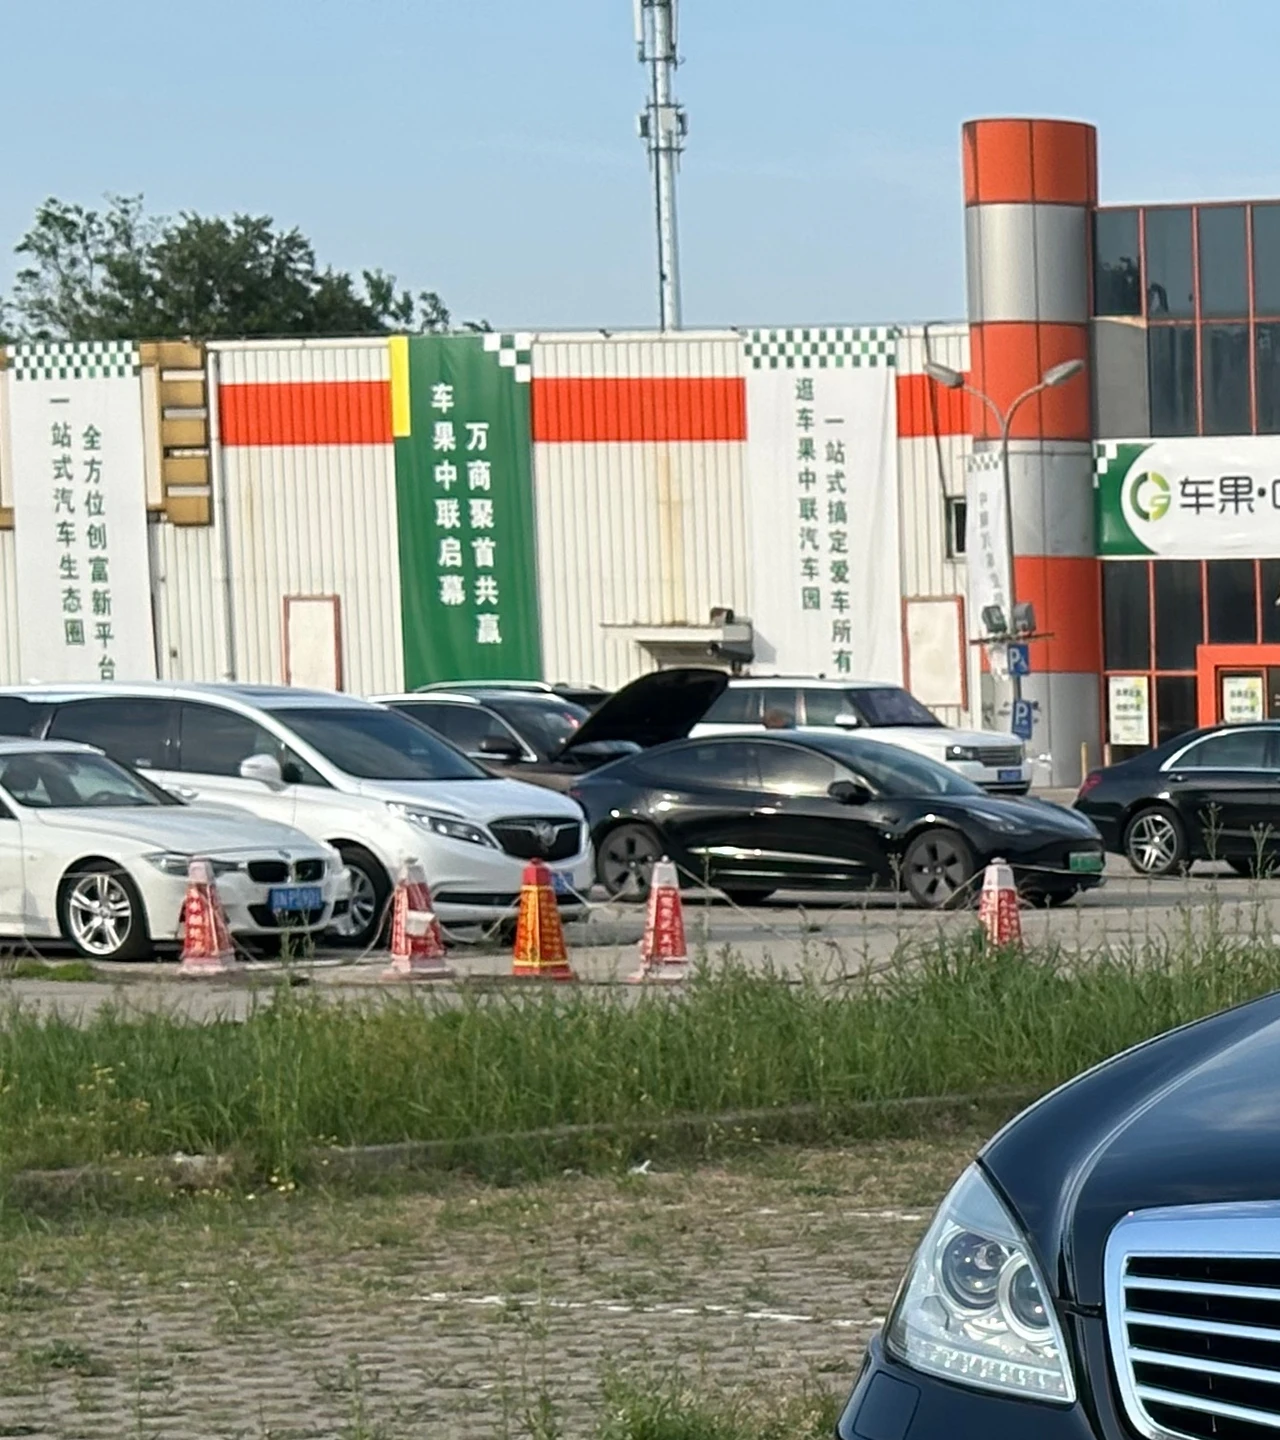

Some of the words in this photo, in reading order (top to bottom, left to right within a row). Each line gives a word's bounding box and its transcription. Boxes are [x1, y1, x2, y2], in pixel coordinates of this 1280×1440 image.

[49, 396, 86, 647] 一站式汽车生态圈
[82, 424, 116, 681] 全方位创富新平台
[430, 382, 466, 606] 车果中联启幕
[465, 421, 502, 645] 万商聚首共赢
[795, 377, 821, 611] 逛车果中联汽车园
[824, 417, 853, 674] 一站式搞定爱车所有
